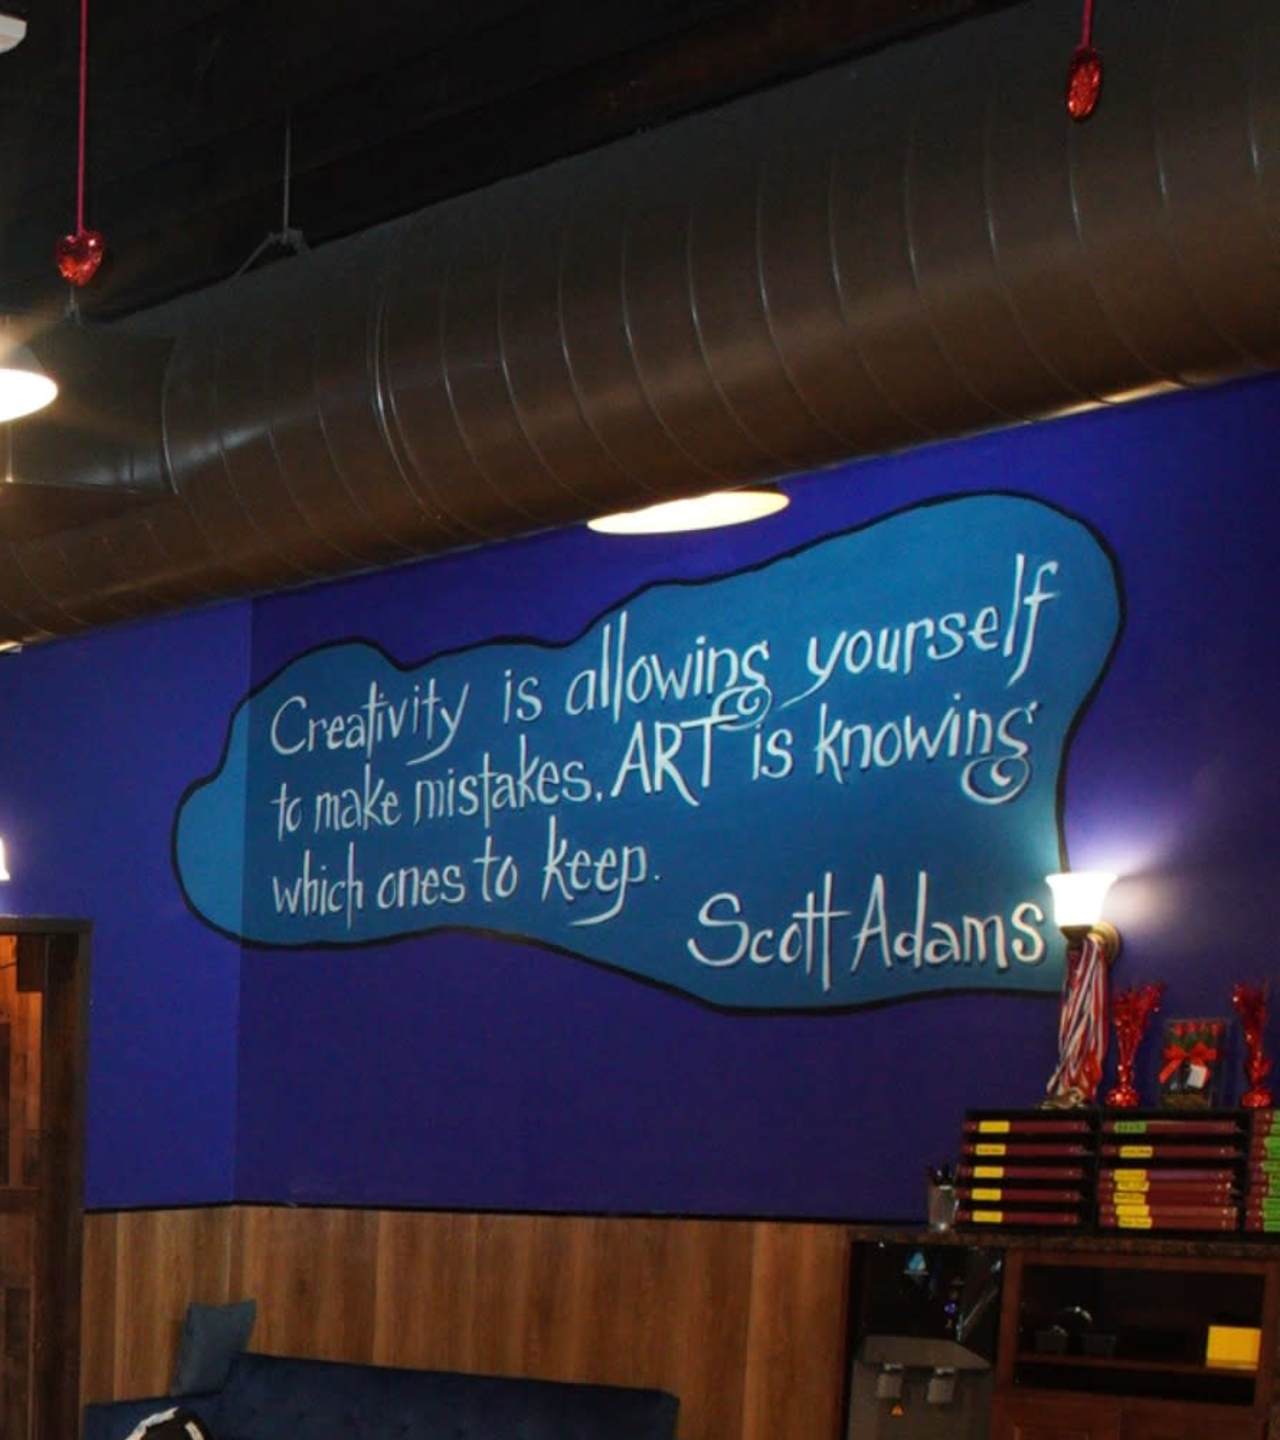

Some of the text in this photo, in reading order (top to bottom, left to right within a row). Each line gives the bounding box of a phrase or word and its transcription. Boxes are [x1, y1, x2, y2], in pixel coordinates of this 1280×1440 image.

[270, 552, 1060, 766] Creativity is allowing yourself
[270, 692, 1040, 842] to make mistakes. ART is knowing
[272, 814, 661, 930] which ones to keep.
[686, 870, 1046, 992] Scott Adams
